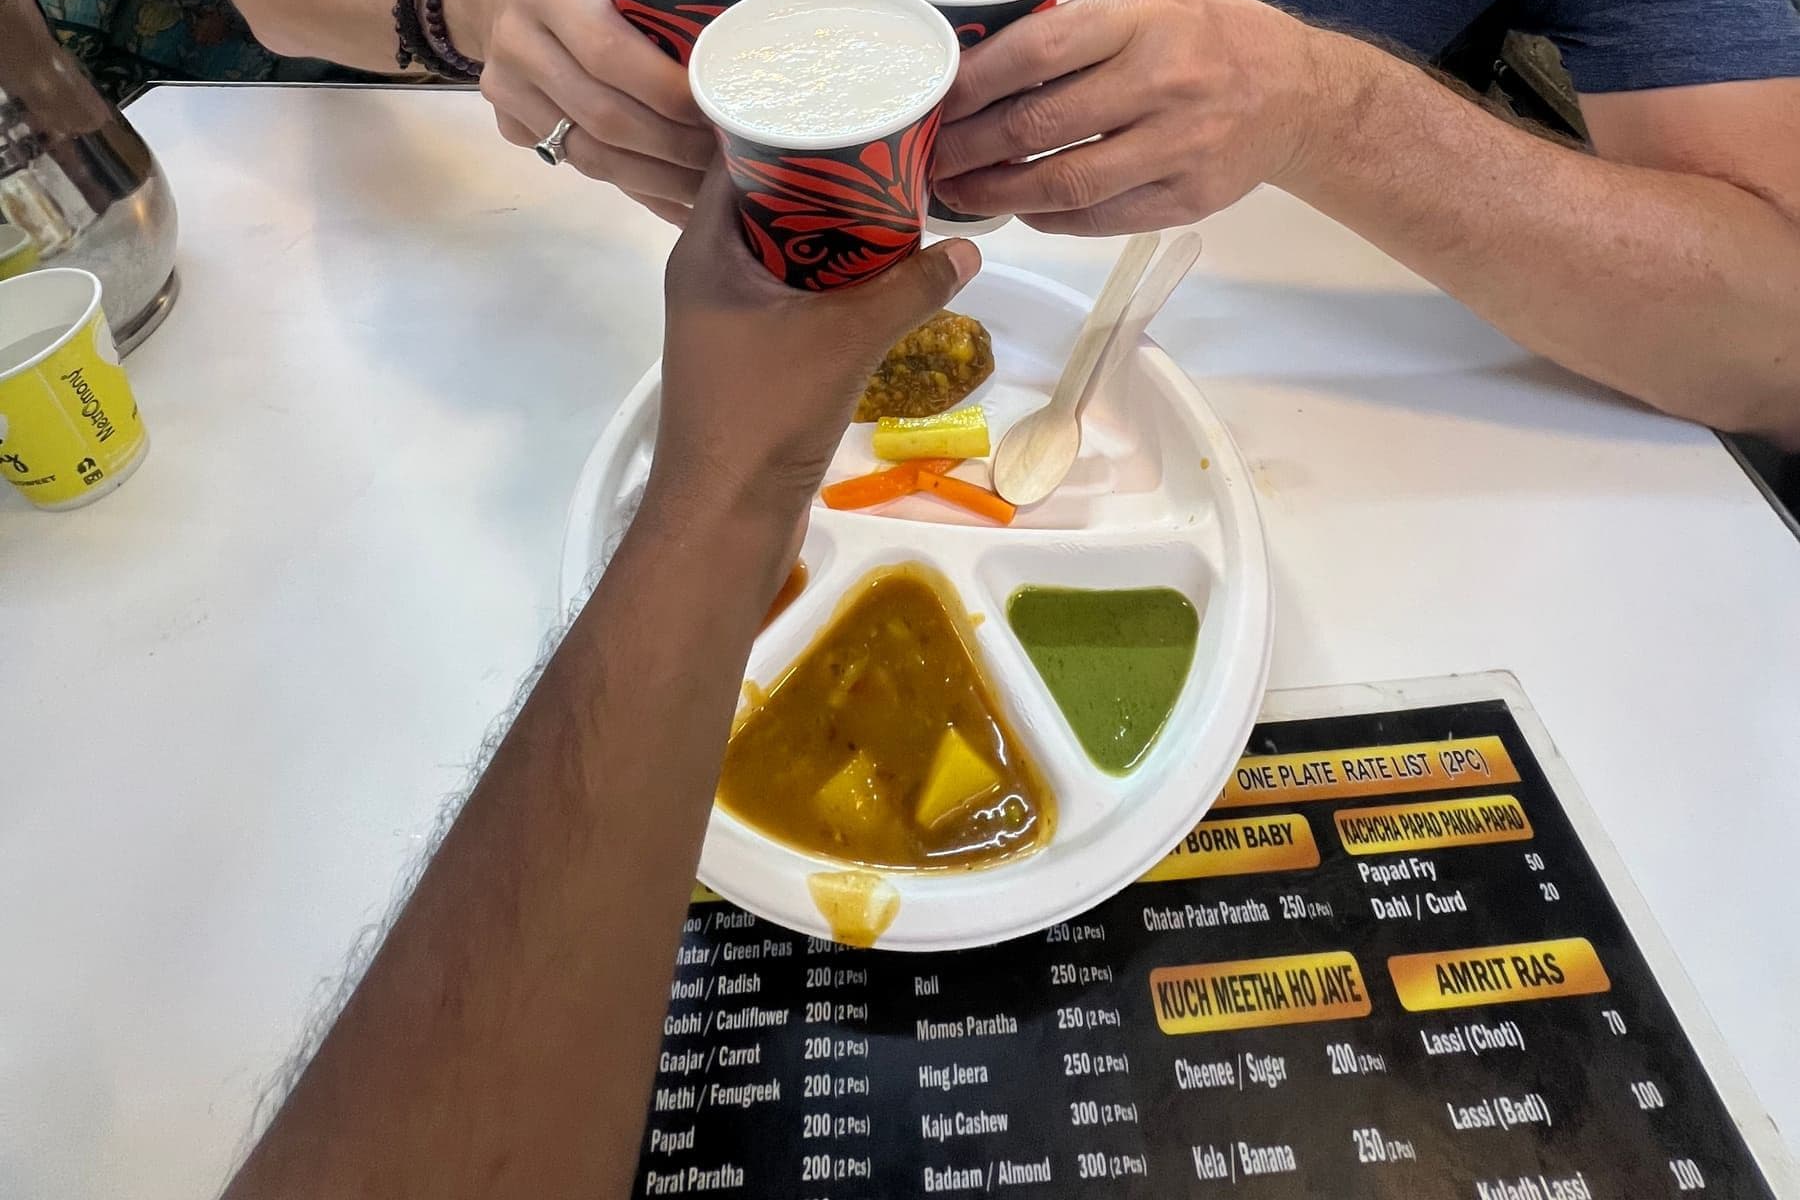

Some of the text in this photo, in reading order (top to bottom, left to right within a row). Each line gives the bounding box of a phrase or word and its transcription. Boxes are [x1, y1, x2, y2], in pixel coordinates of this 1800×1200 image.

[1237, 748, 1490, 791] ONE PLATE RATE LIST (2PC)
[1186, 826, 1241, 855] BORN
[1242, 822, 1294, 849] BABY
[1340, 804, 1525, 846] KACHCHA PAPAD PAKKA PAPAD
[1358, 853, 1545, 886] Papad Fry 50
[1143, 907, 1184, 933] Chatar
[1185, 903, 1219, 929] Patar
[1219, 898, 1270, 926] Paratha
[1280, 895, 1307, 920] 250
[1371, 882, 1560, 920] Dahi / Curd 20
[704, 912, 712, 934] /
[715, 911, 755, 929] Potato
[1047, 923, 1070, 943] 250
[711, 943, 720, 966] /
[724, 942, 760, 961] Green
[763, 939, 792, 958] Peas
[705, 976, 714, 1000] /
[718, 973, 760, 995] Radish
[806, 967, 831, 988] 200
[915, 975, 939, 996] Roll
[1051, 964, 1076, 985] 250
[1157, 965, 1362, 1019] KUCH MEETHA HO JAYE
[1435, 953, 1565, 996] AMRIT RAS
[664, 1012, 702, 1036] Gobhi
[703, 1010, 714, 1037] /
[717, 1006, 789, 1031] Cauliflower
[805, 1002, 831, 1023] 200
[916, 1019, 964, 1041] Momos
[966, 1012, 1018, 1036] Paratha
[1057, 1007, 1084, 1029] 250
[1420, 1010, 1627, 1055] Lassi (Choti) 70
[660, 1050, 705, 1076] Gaajar
[705, 1047, 716, 1073] /
[719, 1043, 761, 1066] Carrot
[805, 1036, 831, 1060] 200
[919, 1065, 951, 1091] Hing
[952, 1063, 988, 1086] Jeera
[1064, 1052, 1091, 1076] 250
[1175, 1058, 1235, 1090] Cheenee
[1246, 1052, 1288, 1088] Suger
[1327, 1043, 1358, 1075] 200
[656, 1086, 695, 1111] Methi
[697, 1084, 707, 1113] /
[711, 1078, 781, 1108] Fenugreek
[804, 1074, 831, 1098] 200
[1447, 1081, 1664, 1131] Lassi (Badi) 100
[651, 1126, 695, 1157] Papad
[803, 1113, 831, 1139] 200
[922, 1113, 953, 1143] Kaju
[955, 1110, 1008, 1136] Cashew
[1070, 1101, 1098, 1125] 300
[924, 1165, 983, 1192] Badaam
[986, 1161, 994, 1192] /
[998, 1156, 1052, 1185] Almond
[1077, 1152, 1107, 1179] 300
[1192, 1144, 1228, 1181] Kela
[1238, 1141, 1297, 1176] Banana
[1353, 1128, 1386, 1163] 250
[646, 1169, 684, 1196] Parat
[688, 1163, 744, 1191] Paratha
[802, 1154, 831, 1181] 200
[1670, 1159, 1705, 1190] 100
